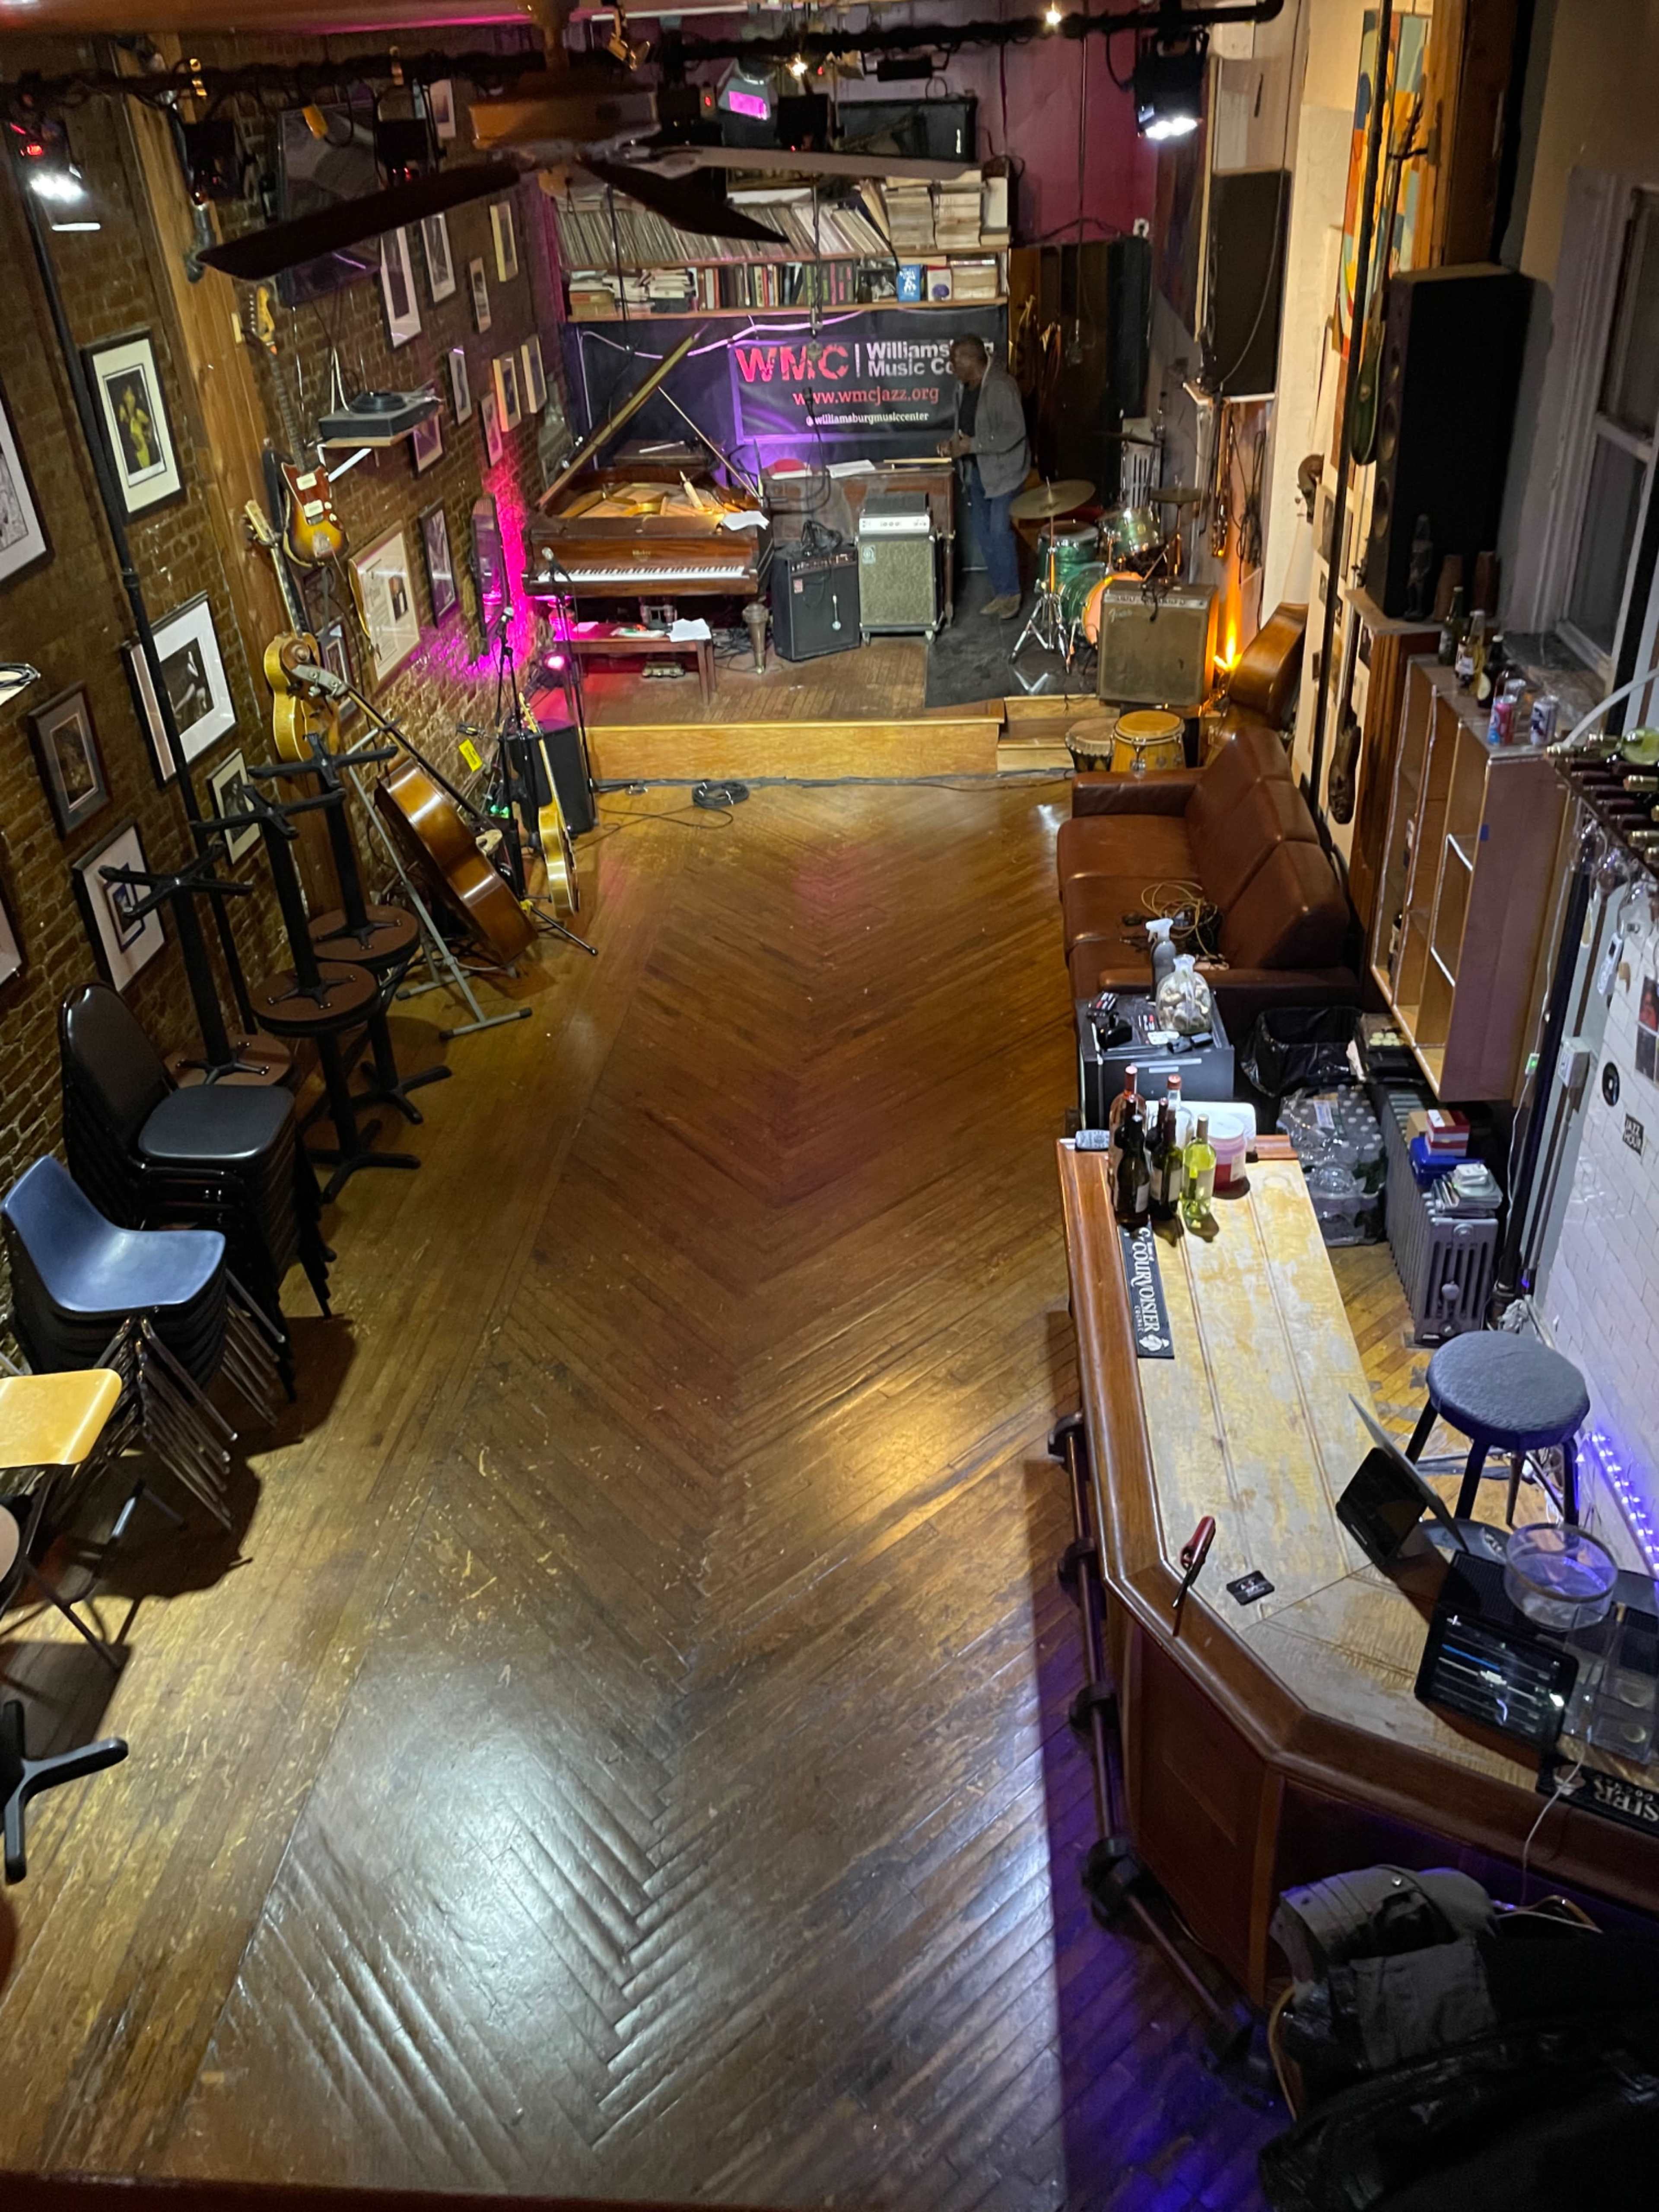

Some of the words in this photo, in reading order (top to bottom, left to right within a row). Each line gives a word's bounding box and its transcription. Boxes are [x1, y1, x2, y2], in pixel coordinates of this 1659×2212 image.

[735, 344, 849, 382] WMC
[868, 357, 925, 377] Music
[793, 386, 939, 406] www.wmcjazz.org
[1131, 1241, 1160, 1332] COURVOISIER
